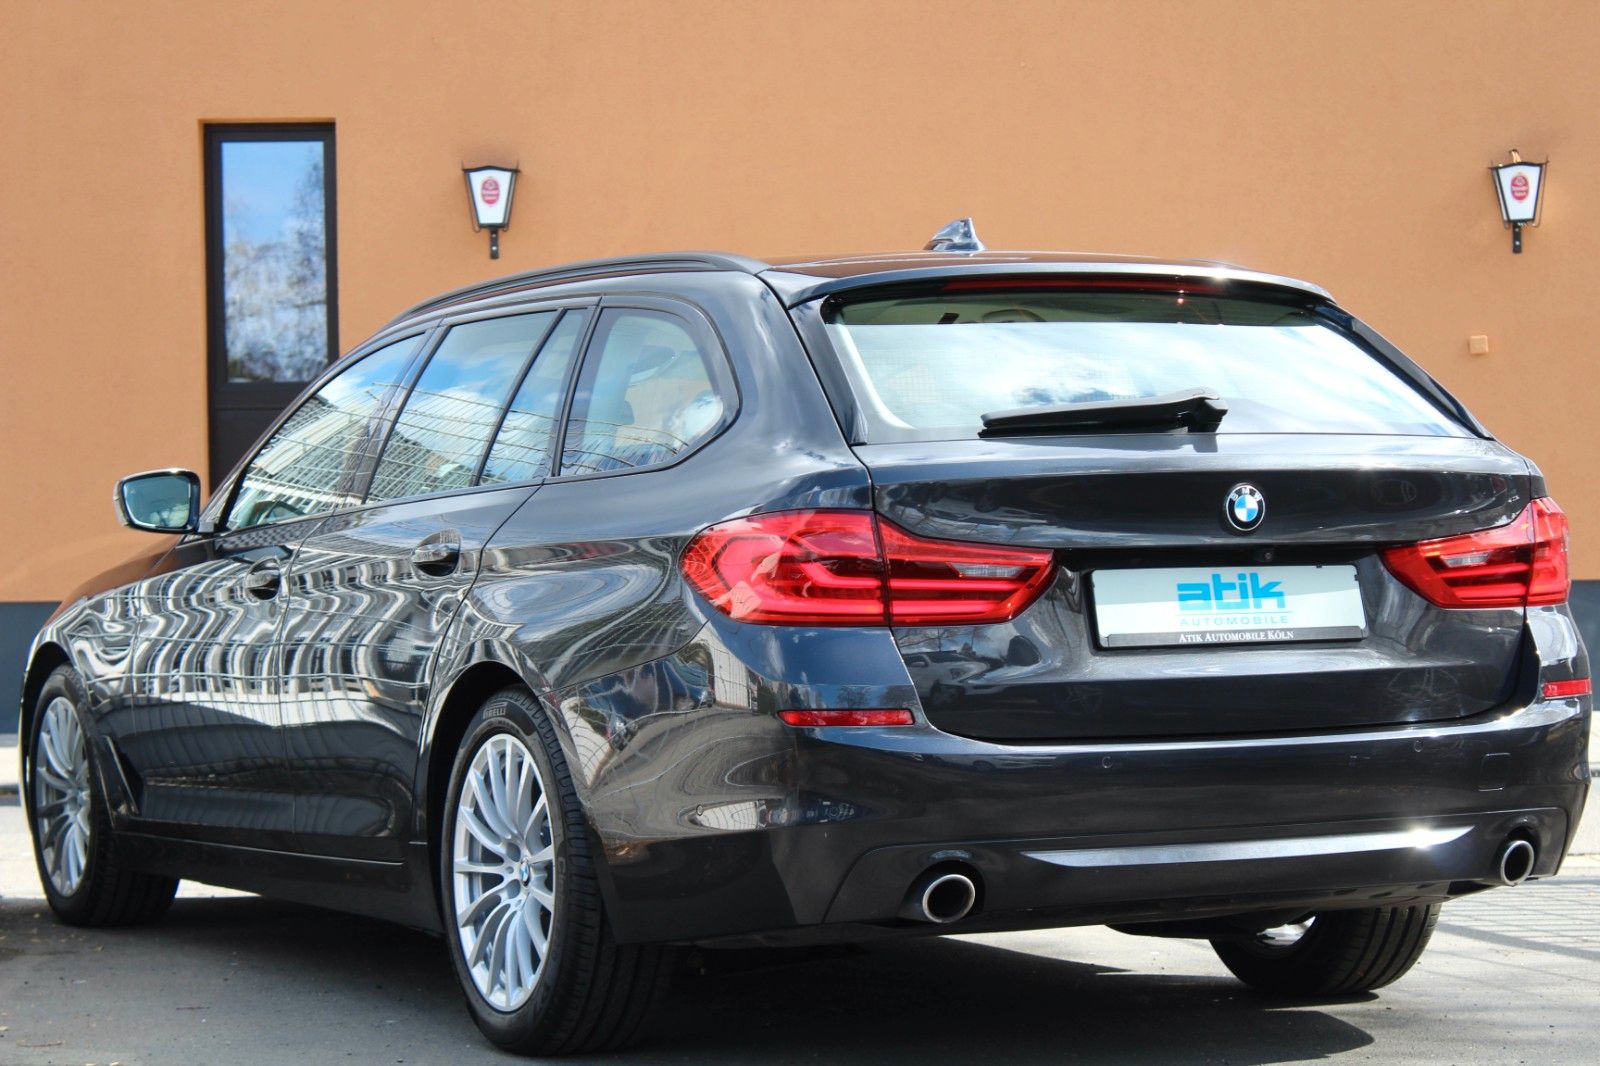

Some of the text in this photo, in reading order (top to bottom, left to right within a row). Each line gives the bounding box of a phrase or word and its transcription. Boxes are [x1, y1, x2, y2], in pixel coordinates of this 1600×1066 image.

[1230, 486, 1263, 501] BMW
[1177, 572, 1286, 610] atik
[1180, 615, 1289, 627] AUTOMOBILE
[1179, 629, 1295, 643] ATIK AUTOMOBILE KÖLN
